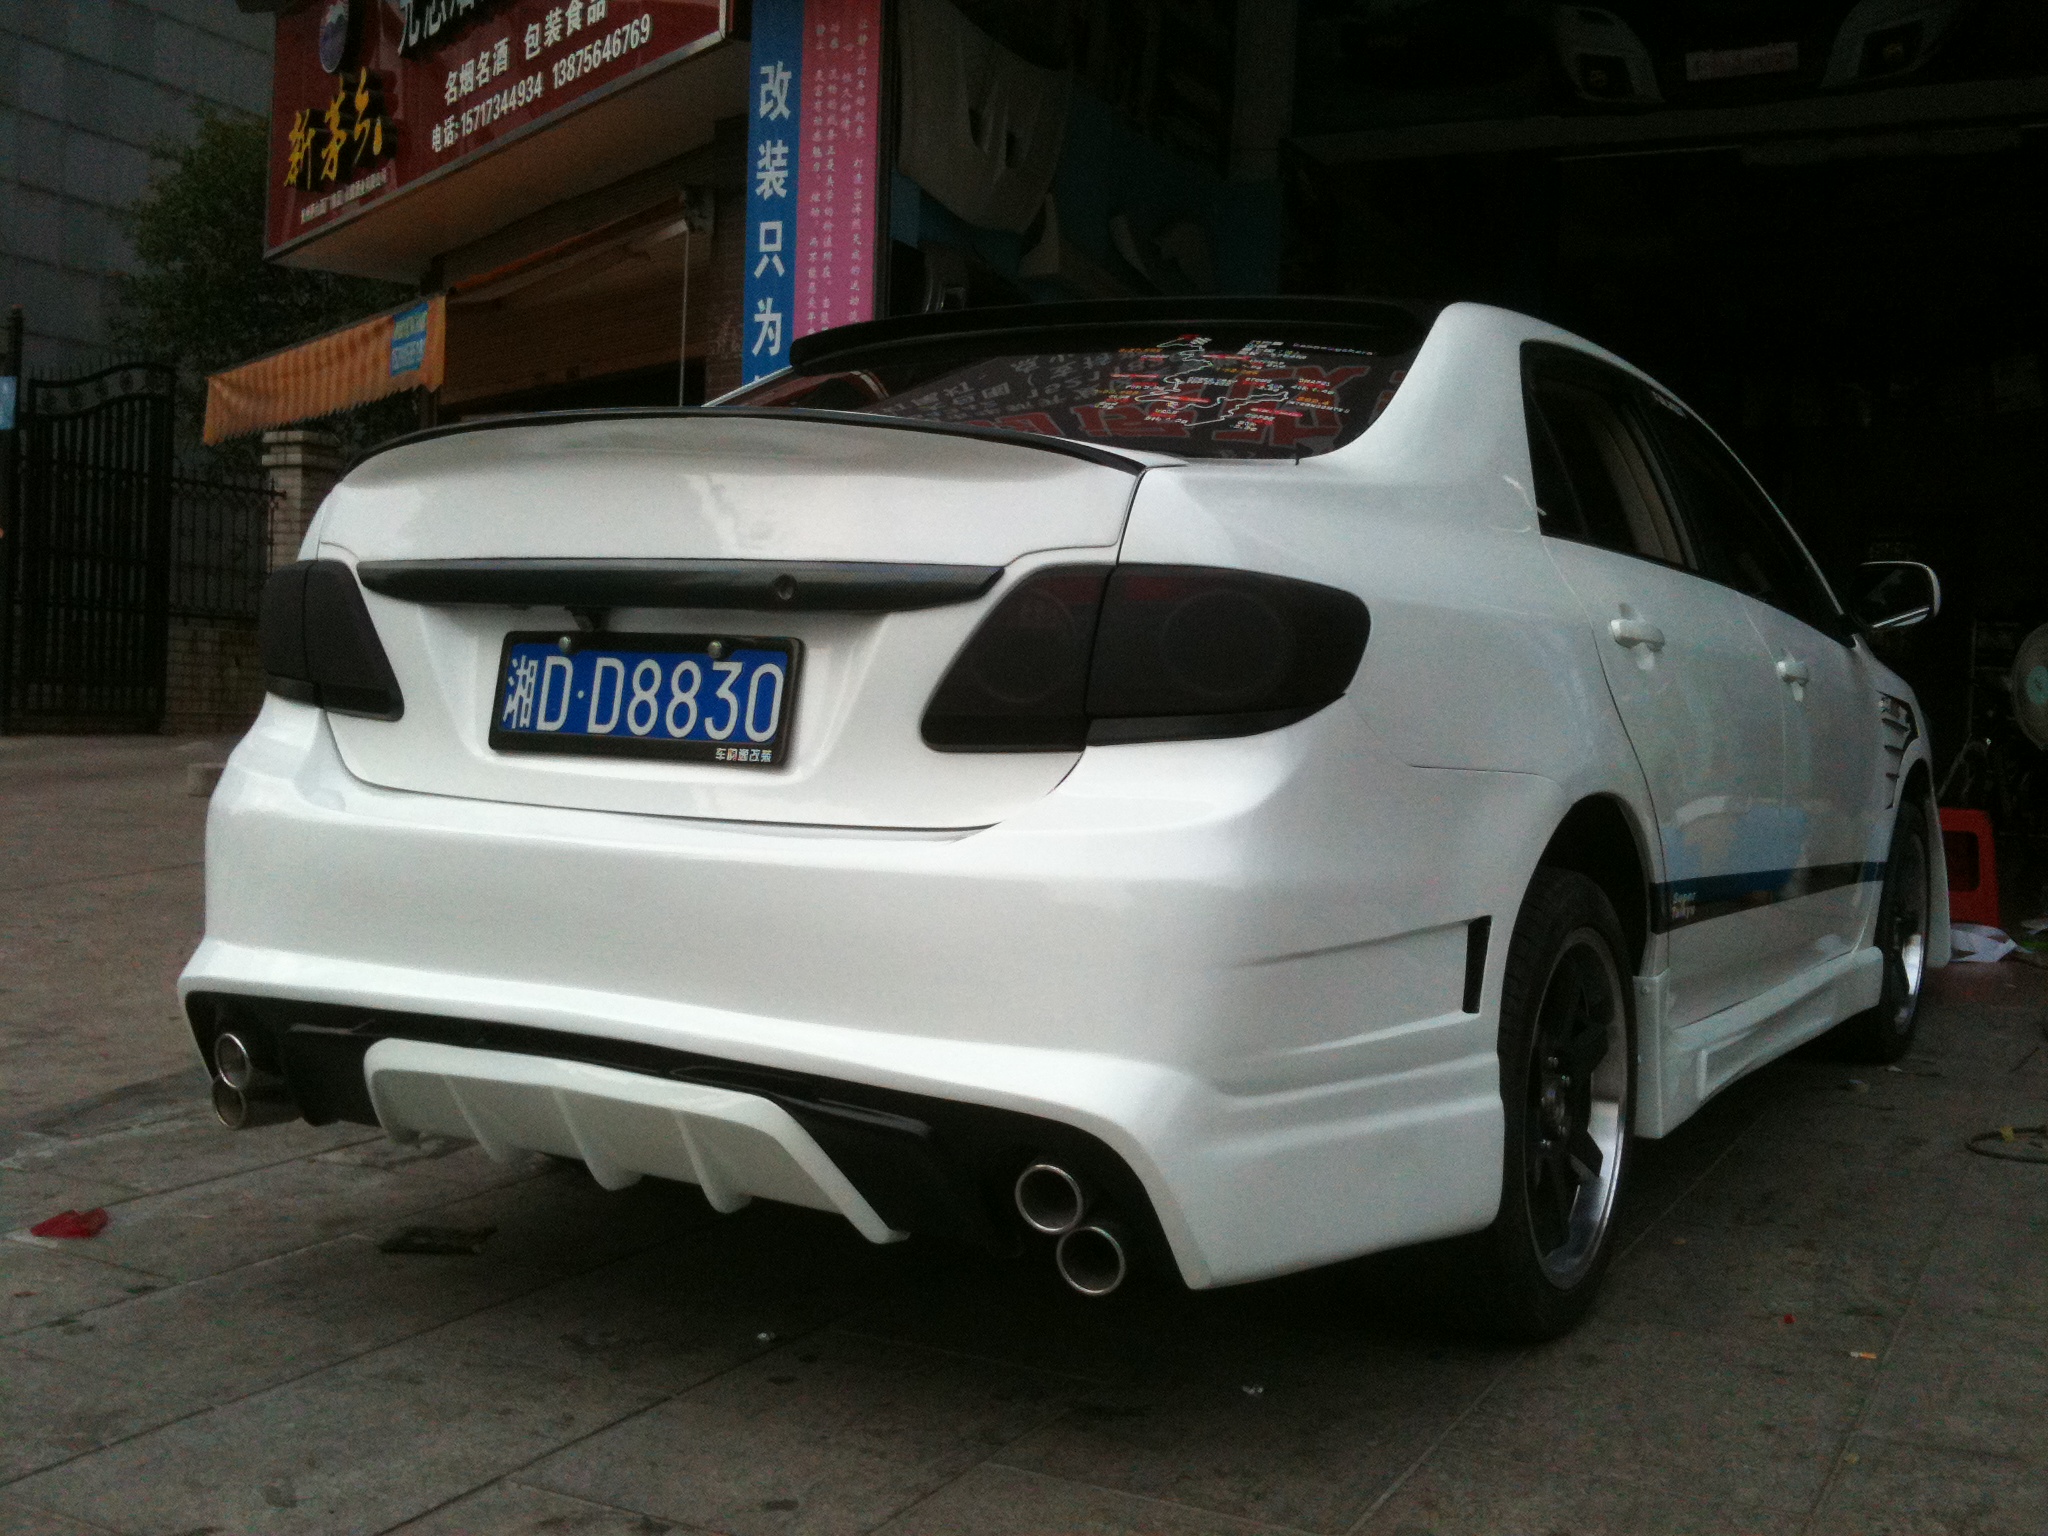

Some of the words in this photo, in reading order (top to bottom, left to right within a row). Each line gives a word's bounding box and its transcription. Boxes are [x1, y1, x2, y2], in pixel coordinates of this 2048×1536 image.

[444, 37, 510, 106] 名烟名酒
[523, 0, 608, 61] 包装食品
[552, 13, 653, 90] 13875646769
[752, 60, 793, 383] 改装只为
